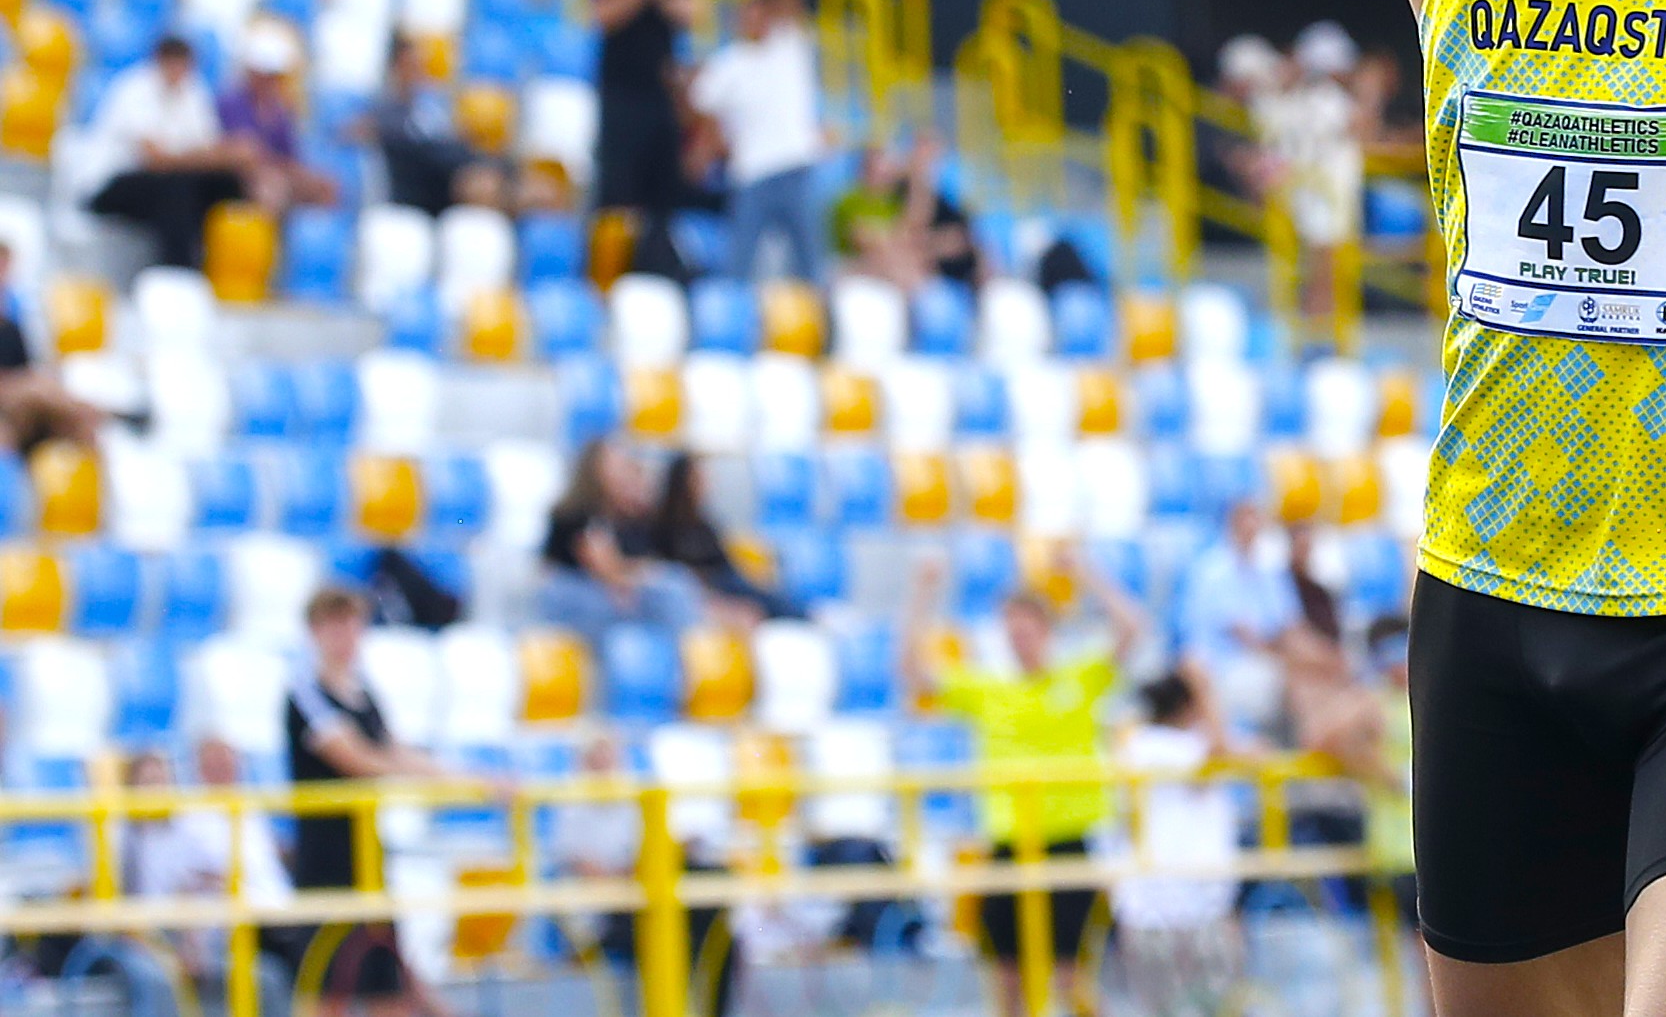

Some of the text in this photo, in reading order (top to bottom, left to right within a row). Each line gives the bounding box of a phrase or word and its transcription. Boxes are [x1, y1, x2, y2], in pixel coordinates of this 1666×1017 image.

[1510, 111, 1660, 135] #QAZAQATHLETICS
[1507, 129, 1659, 153] #CLEANATHLETICS
[1517, 165, 1642, 265] 45
[1520, 262, 1636, 285] PLAY TRUE!
[1577, 324, 1640, 334] GENERAL PARTNER
